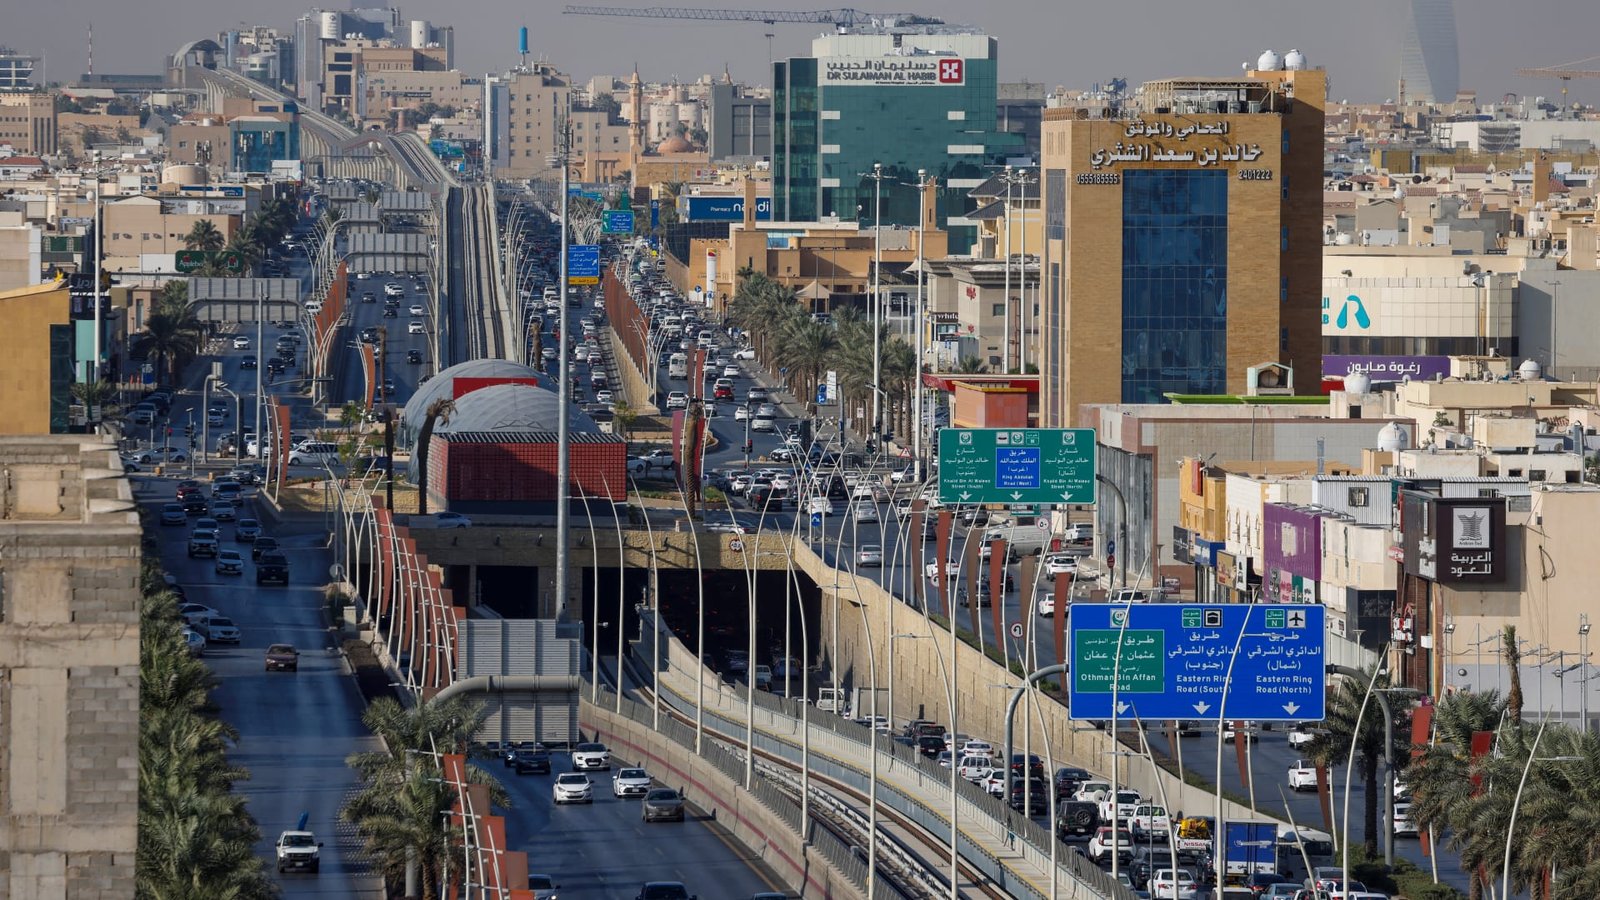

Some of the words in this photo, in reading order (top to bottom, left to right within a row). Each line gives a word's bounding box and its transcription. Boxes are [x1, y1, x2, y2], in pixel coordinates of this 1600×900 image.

[827, 60, 872, 71] الحبيب
[827, 71, 841, 80] DR
[842, 71, 892, 80] SULAIMAN
[894, 71, 907, 80] AL
[908, 71, 937, 80] HABIB
[1124, 119, 1173, 137] والموثق
[1176, 121, 1228, 140] المحامي
[1091, 141, 1149, 170] الشثري
[1152, 148, 1195, 163] سعد
[1198, 144, 1218, 165] بن
[1222, 143, 1263, 163] خالد
[1077, 173, 1119, 184] 0555185555
[1238, 169, 1272, 180] 2401222
[1347, 361, 1386, 375] صابون
[1389, 361, 1421, 375] رغوة
[956, 447, 976, 456] شارع
[1009, 449, 1027, 457] طريق
[1058, 447, 1079, 456] شارع
[944, 457, 966, 465] الوليد
[1044, 457, 1066, 465] الوليد
[1451, 551, 1492, 565] العربية
[1451, 563, 1492, 577] للعود
[1188, 619, 1195, 627] S
[1124, 635, 1155, 646] طريق
[1189, 630, 1220, 641] طريق
[1268, 631, 1300, 641] طريق
[1084, 650, 1108, 661] عفان
[1127, 650, 1155, 661] عثمان
[1168, 645, 1204, 659] الشرقي
[1206, 645, 1242, 657] ادائري
[1247, 645, 1284, 659] الشرقي
[1285, 646, 1321, 657] الدائري
[1185, 660, 1224, 671] (جنوب)
[1267, 660, 1302, 671] (شمال)
[1256, 675, 1291, 683] Eastern
[1293, 675, 1312, 684] Ring
[1176, 685, 1198, 693] Road
[1199, 686, 1232, 694] (Sout)
[1279, 686, 1312, 694] (North)
